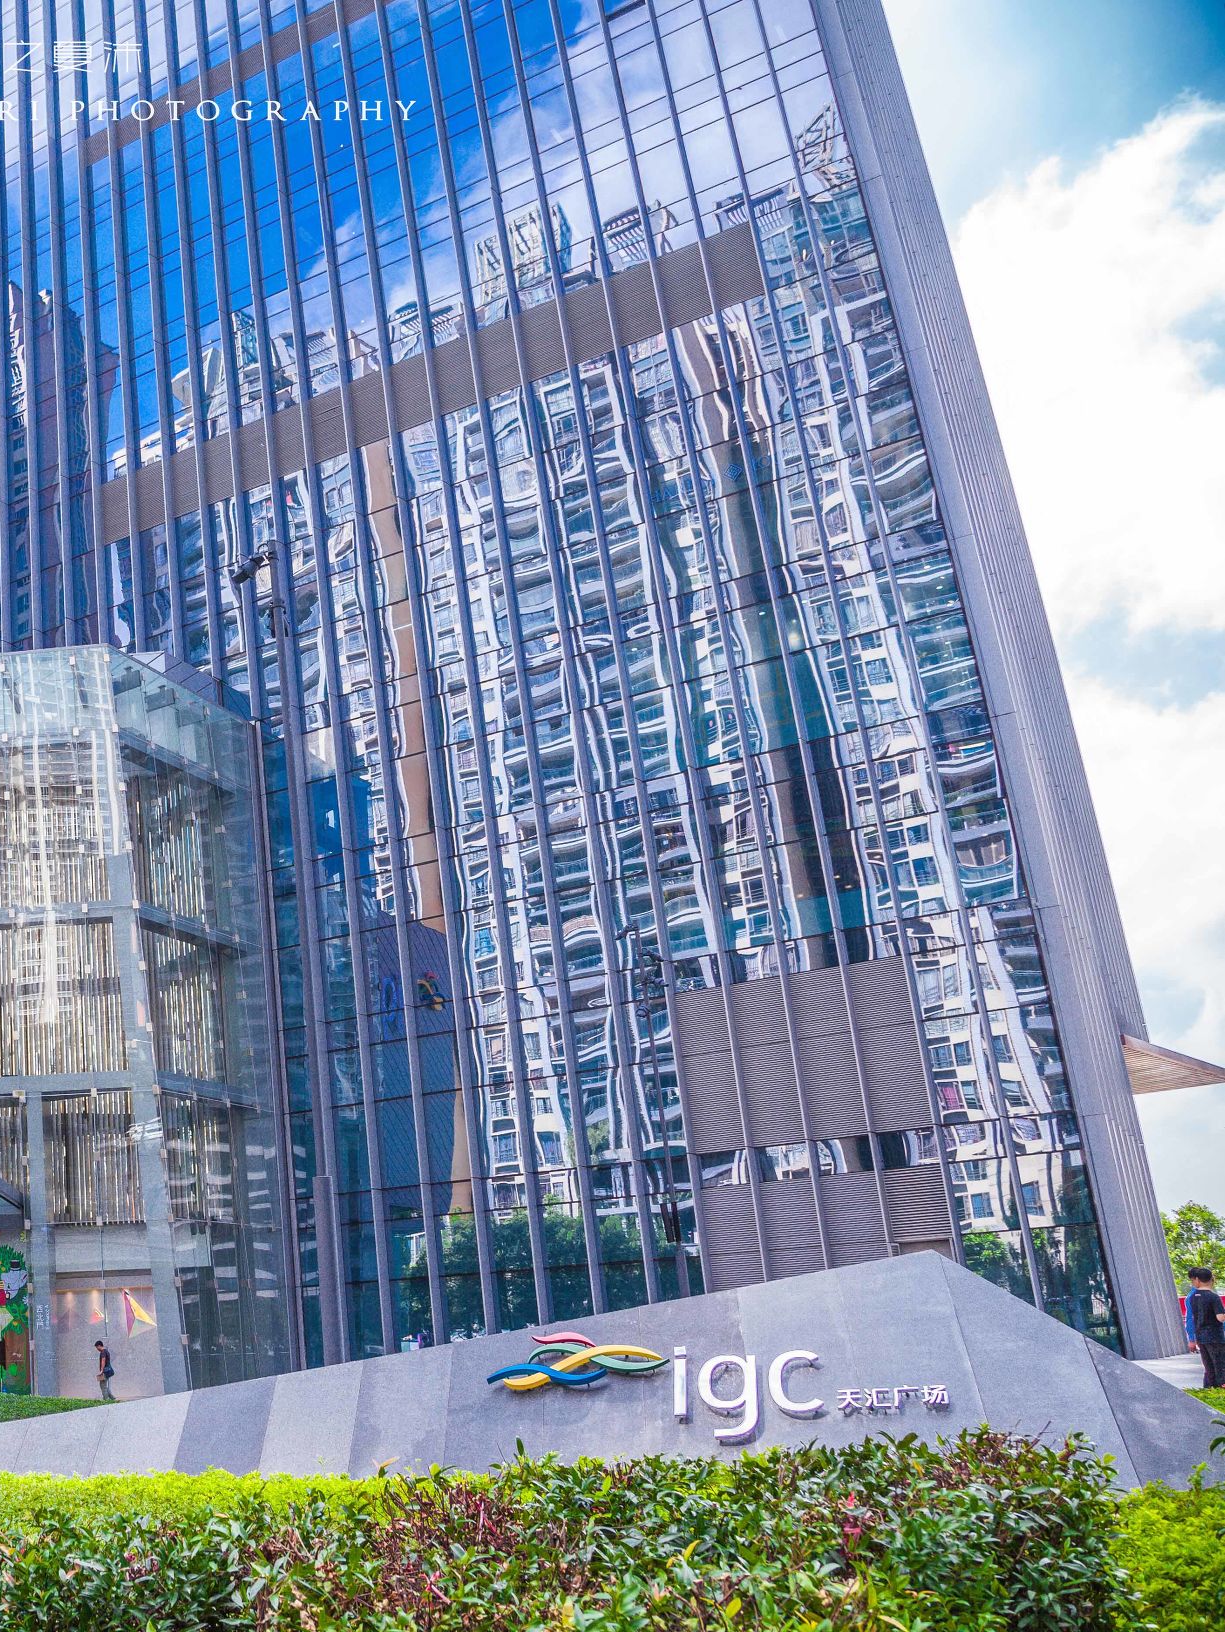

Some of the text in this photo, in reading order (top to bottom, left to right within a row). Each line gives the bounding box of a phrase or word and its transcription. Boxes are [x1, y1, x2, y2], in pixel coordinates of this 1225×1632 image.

[674, 1346, 825, 1439] igc
[836, 1384, 950, 1411] 天汇广场
